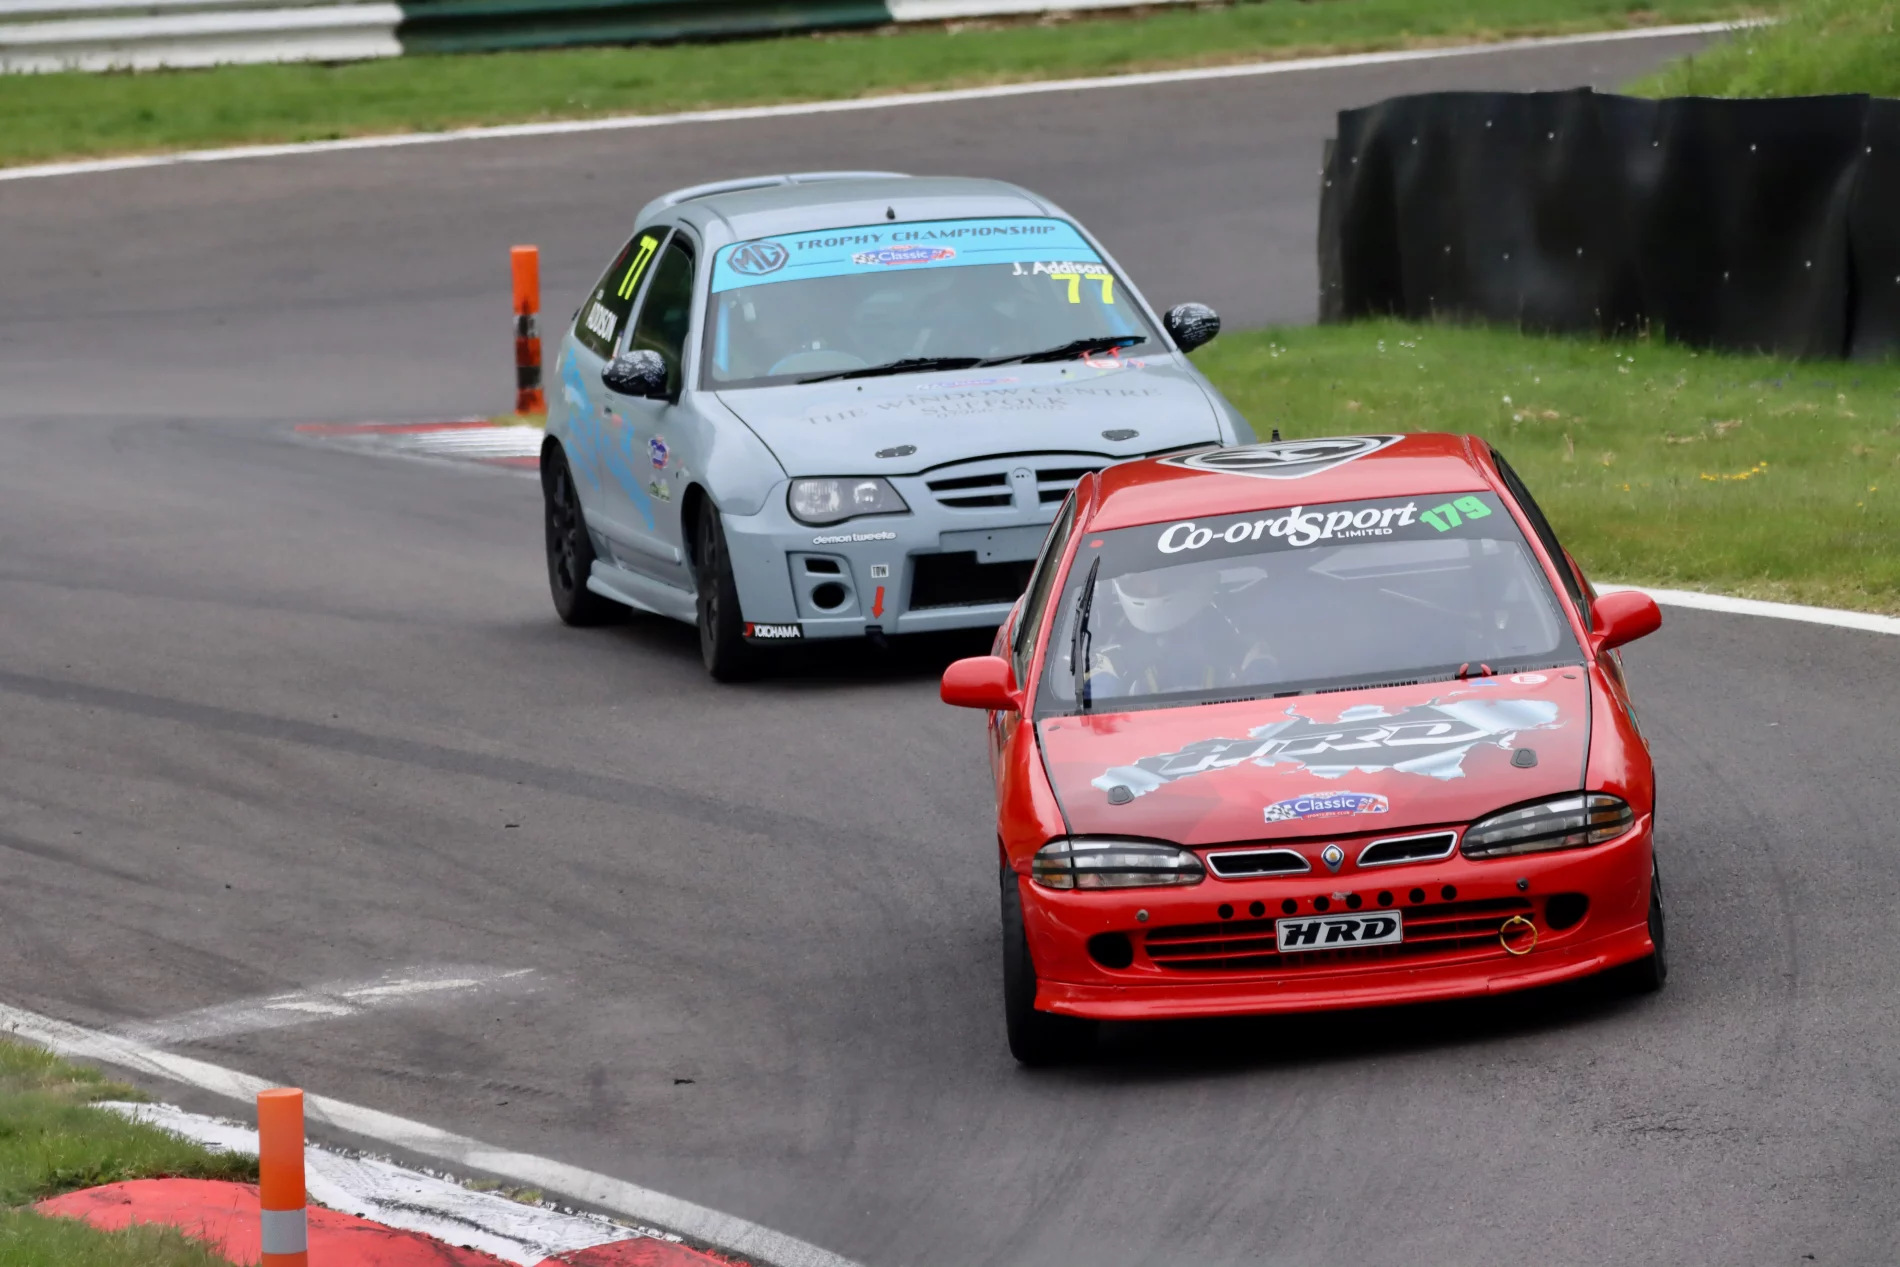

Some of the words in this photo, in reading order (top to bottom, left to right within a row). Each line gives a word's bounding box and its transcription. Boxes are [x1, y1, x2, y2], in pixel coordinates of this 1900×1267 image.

[795, 232, 885, 250] TROPHY
[892, 225, 1057, 242] CHAMPIONSHIP
[732, 242, 784, 273] MG
[878, 249, 929, 261] Classic
[1012, 261, 1028, 276] J.
[1033, 260, 1110, 275] Addison
[1052, 273, 1114, 304] 77
[806, 407, 867, 425] THE
[877, 387, 1019, 411] WINDOW
[1031, 387, 1162, 397] CENTRE
[1419, 495, 1492, 533] 179
[1157, 502, 1417, 554] Co-ordSport
[1337, 527, 1392, 539] LIMITED
[872, 565, 888, 577] TOW
[754, 624, 801, 638] YOKOHAMA
[1294, 797, 1355, 812] Classic
[1283, 916, 1397, 947] HRD
